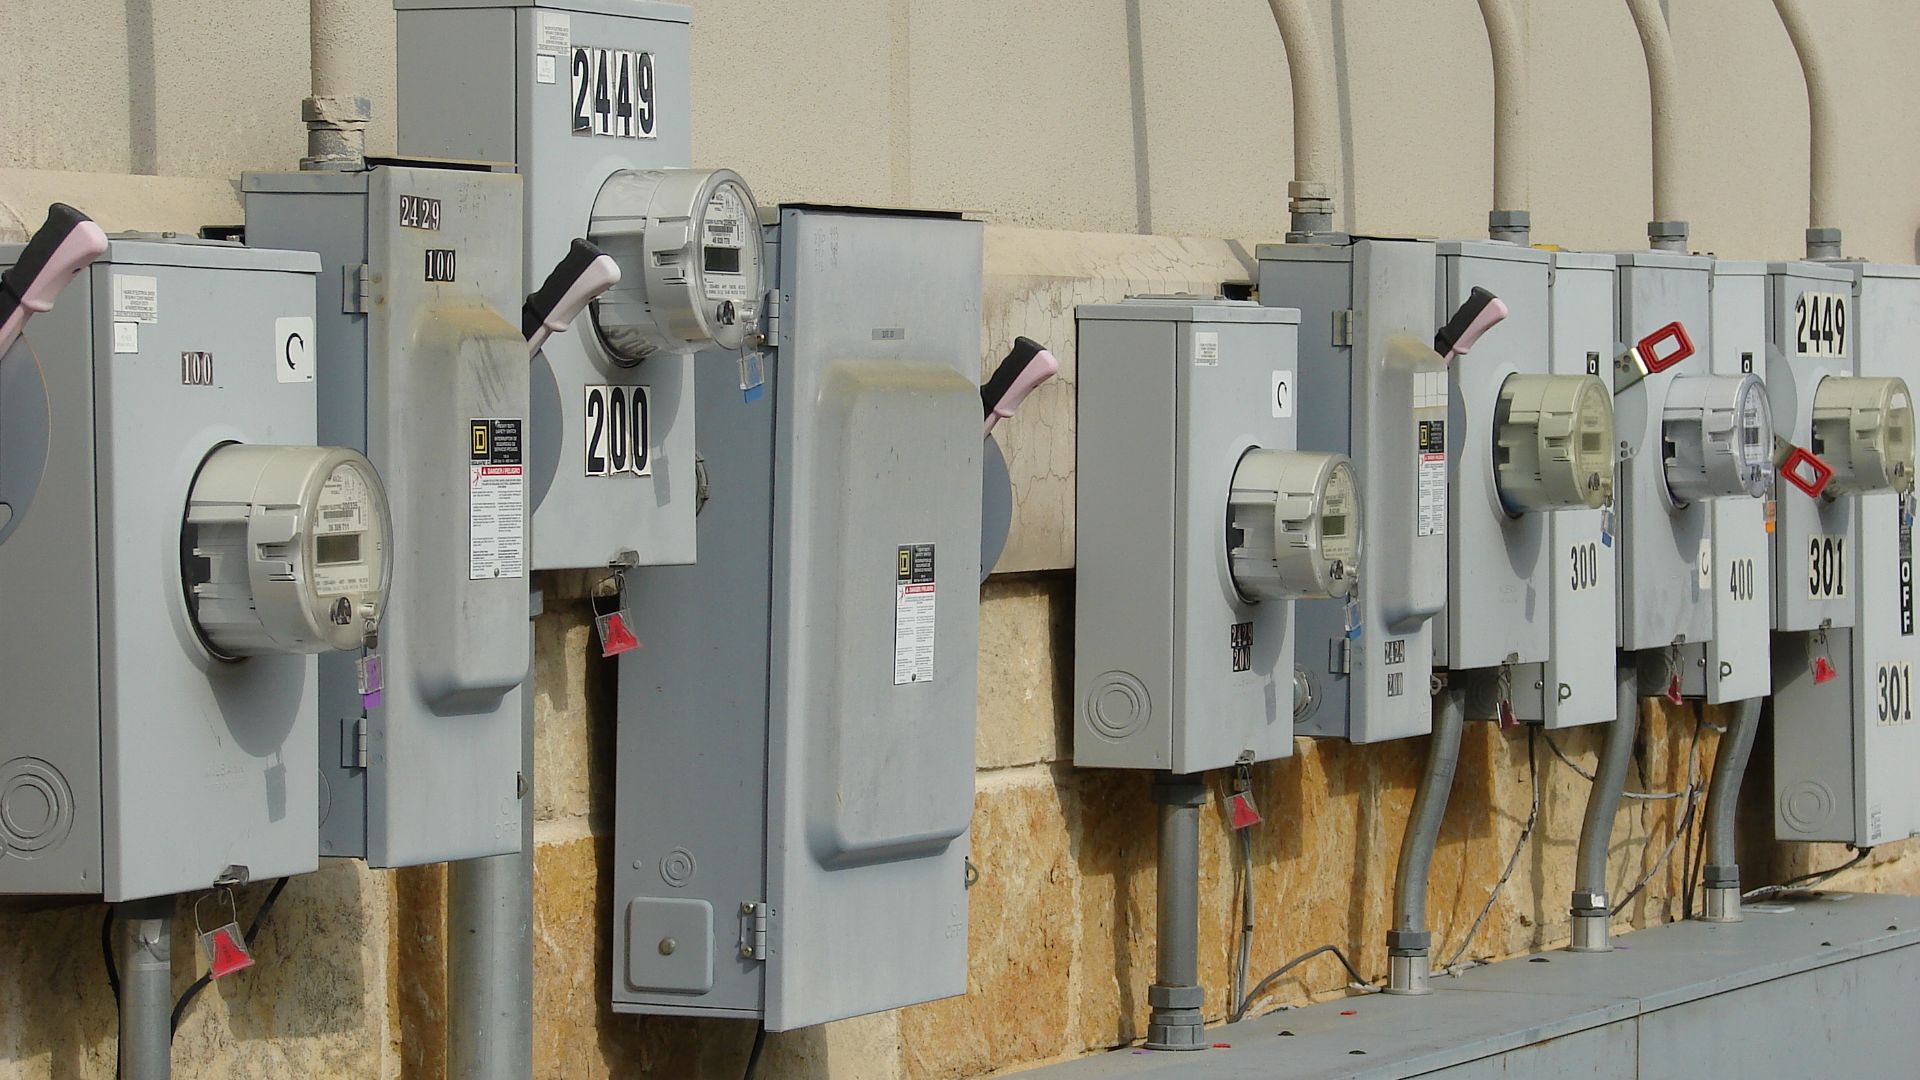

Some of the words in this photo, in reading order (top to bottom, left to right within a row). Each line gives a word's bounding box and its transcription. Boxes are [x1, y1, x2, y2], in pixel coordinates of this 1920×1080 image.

[573, 48, 654, 135] 2449
[401, 196, 440, 230] 2429
[427, 250, 454, 280] 100
[1796, 295, 1845, 355] 2449
[183, 353, 211, 385] 100
[587, 386, 648, 472] 200
[1571, 542, 1597, 590] 300
[1730, 558, 1753, 601] 400
[1809, 537, 1844, 596] 301
[1901, 561, 1910, 632] OFF
[1231, 624, 1252, 647] 2429
[1385, 640, 1404, 663] 2429
[1233, 648, 1251, 671] 200
[1388, 673, 1403, 695] 200
[1878, 664, 1911, 722] 301
